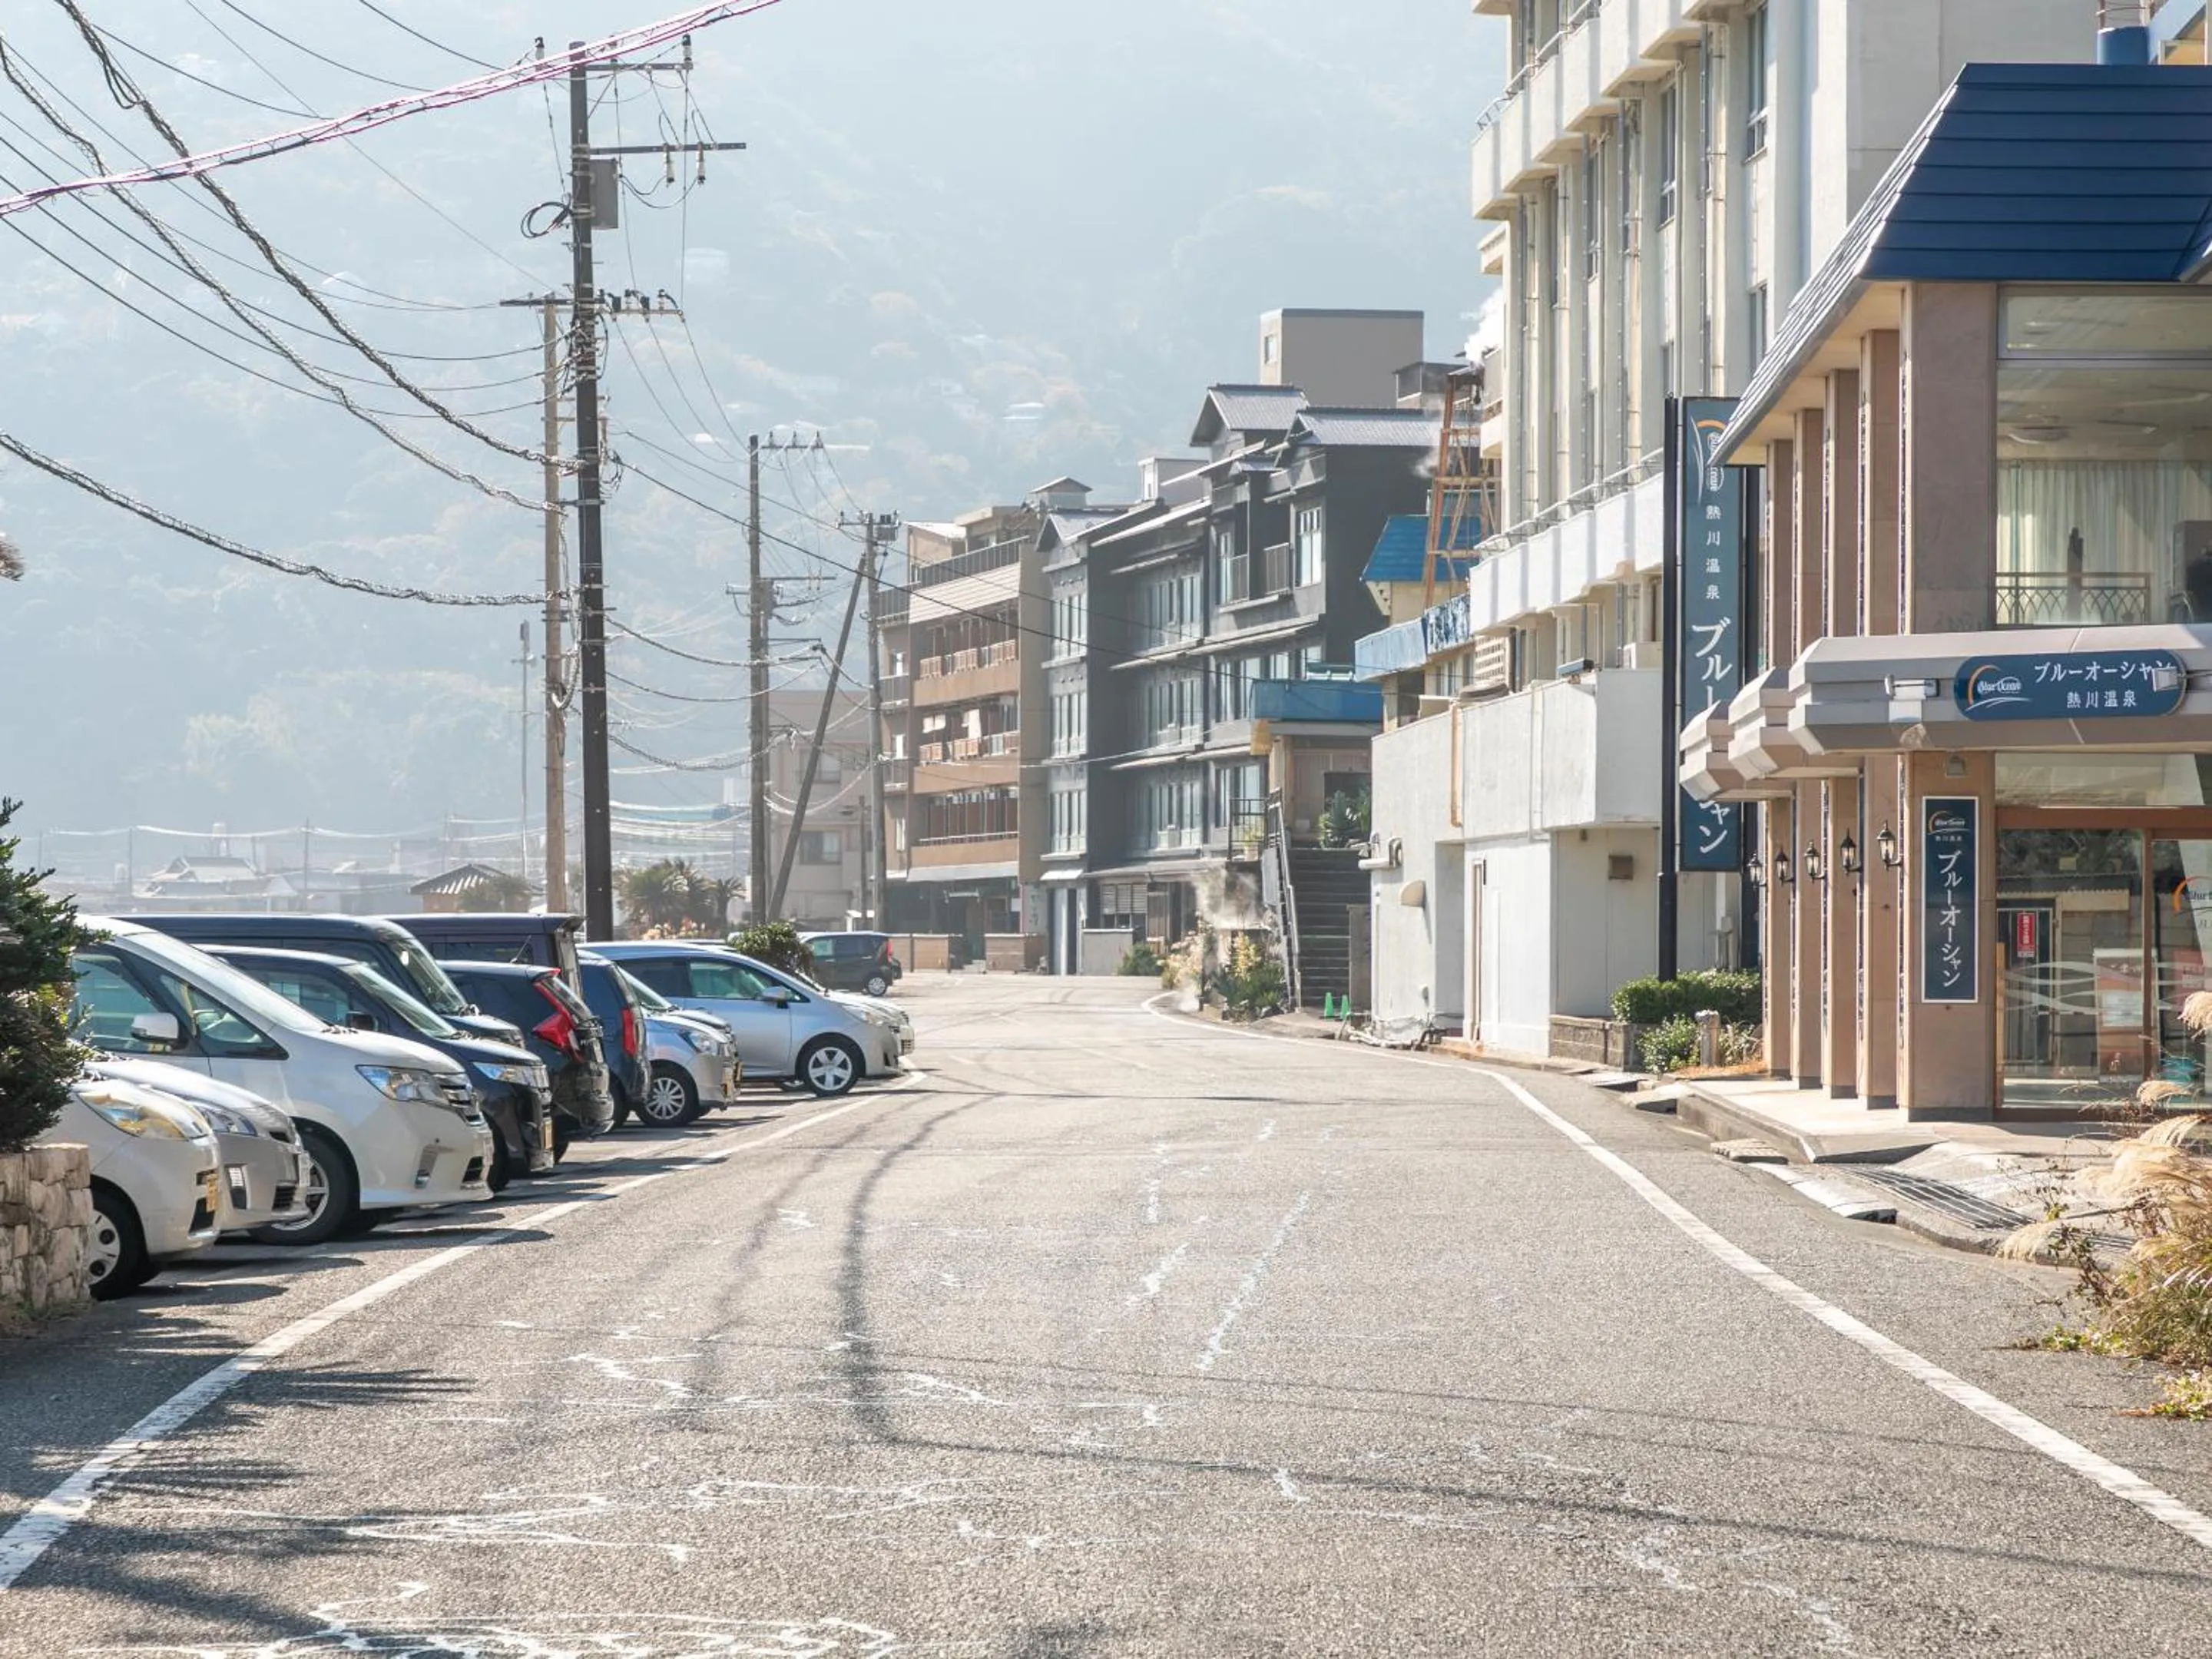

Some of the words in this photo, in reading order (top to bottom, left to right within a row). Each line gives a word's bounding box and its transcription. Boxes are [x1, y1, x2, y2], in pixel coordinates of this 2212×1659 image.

[1705, 505, 1722, 600] 熱川温泉
[1691, 616, 1733, 854] ブルーャン
[2066, 690, 2137, 709] 熱川温泉
[1938, 850, 1962, 988] ブルーオーシャン
